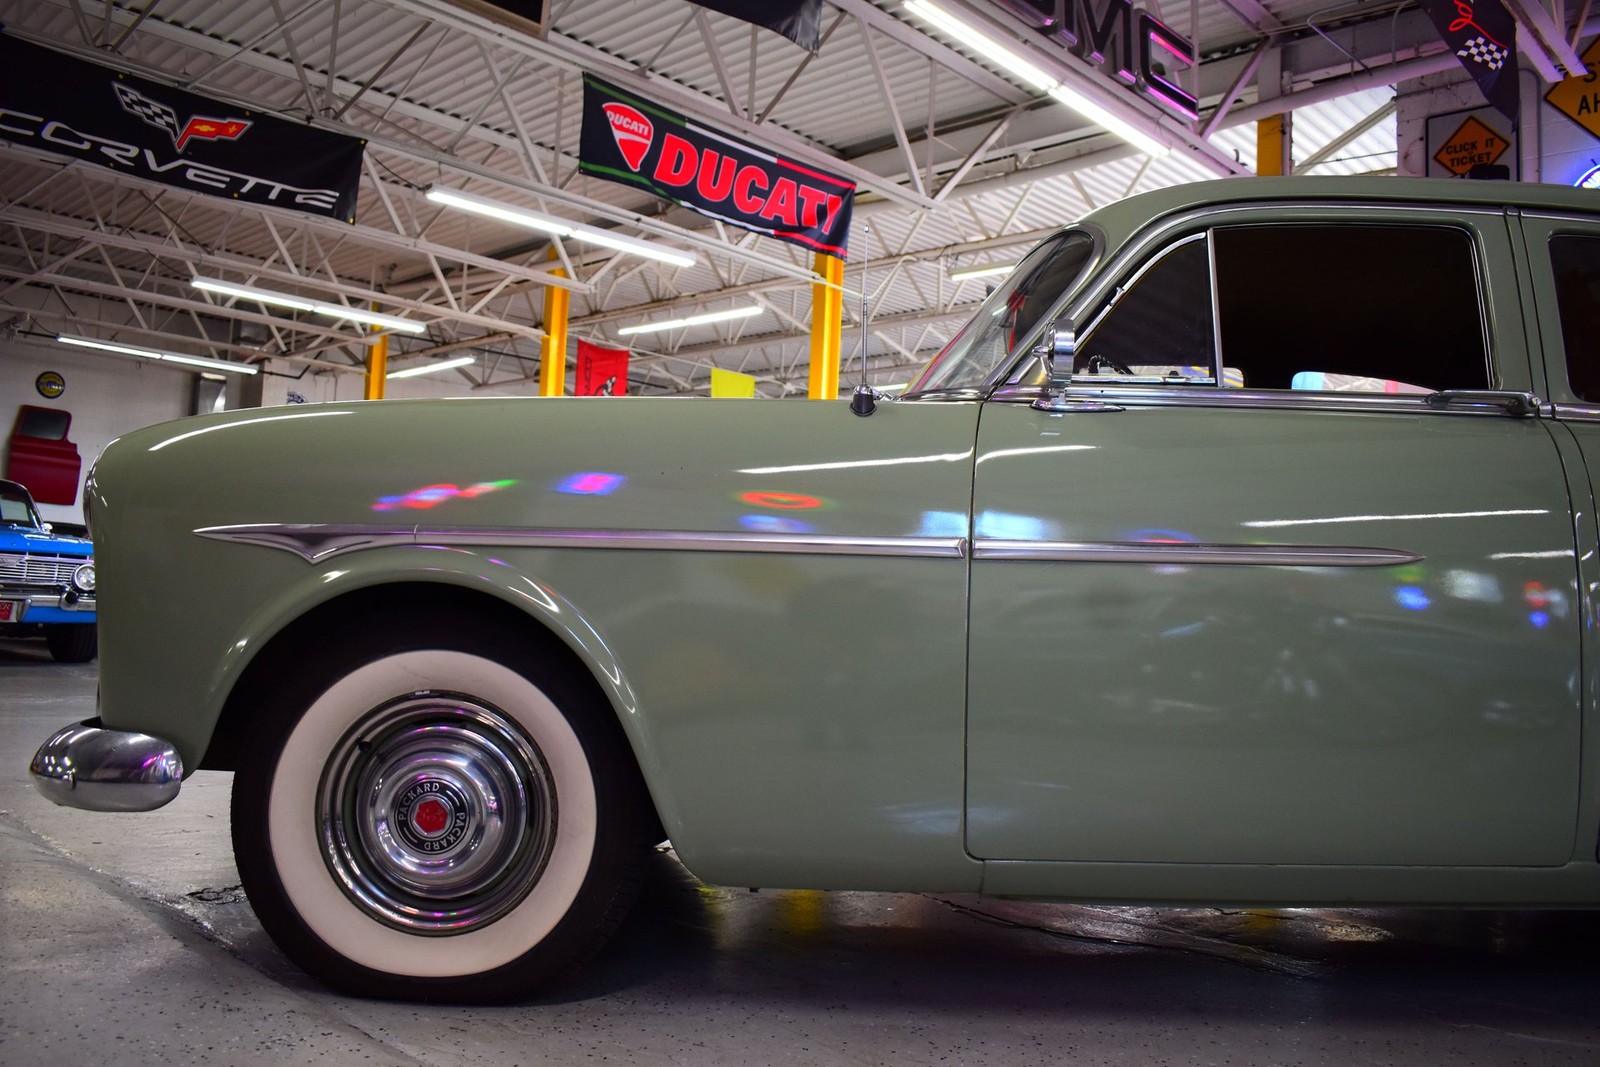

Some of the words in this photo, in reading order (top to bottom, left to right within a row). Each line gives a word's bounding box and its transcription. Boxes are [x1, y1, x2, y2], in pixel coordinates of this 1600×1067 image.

[1583, 61, 1600, 84] S
[606, 109, 650, 137] DUCATI
[0, 107, 340, 210] CORVETTE
[1446, 140, 1478, 155] CLICK
[1485, 137, 1496, 148] IT
[1449, 151, 1492, 168] TICKET
[653, 132, 843, 235] DUCATI
[398, 782, 440, 821] PACKARD
[423, 812, 466, 851] PACKARD
